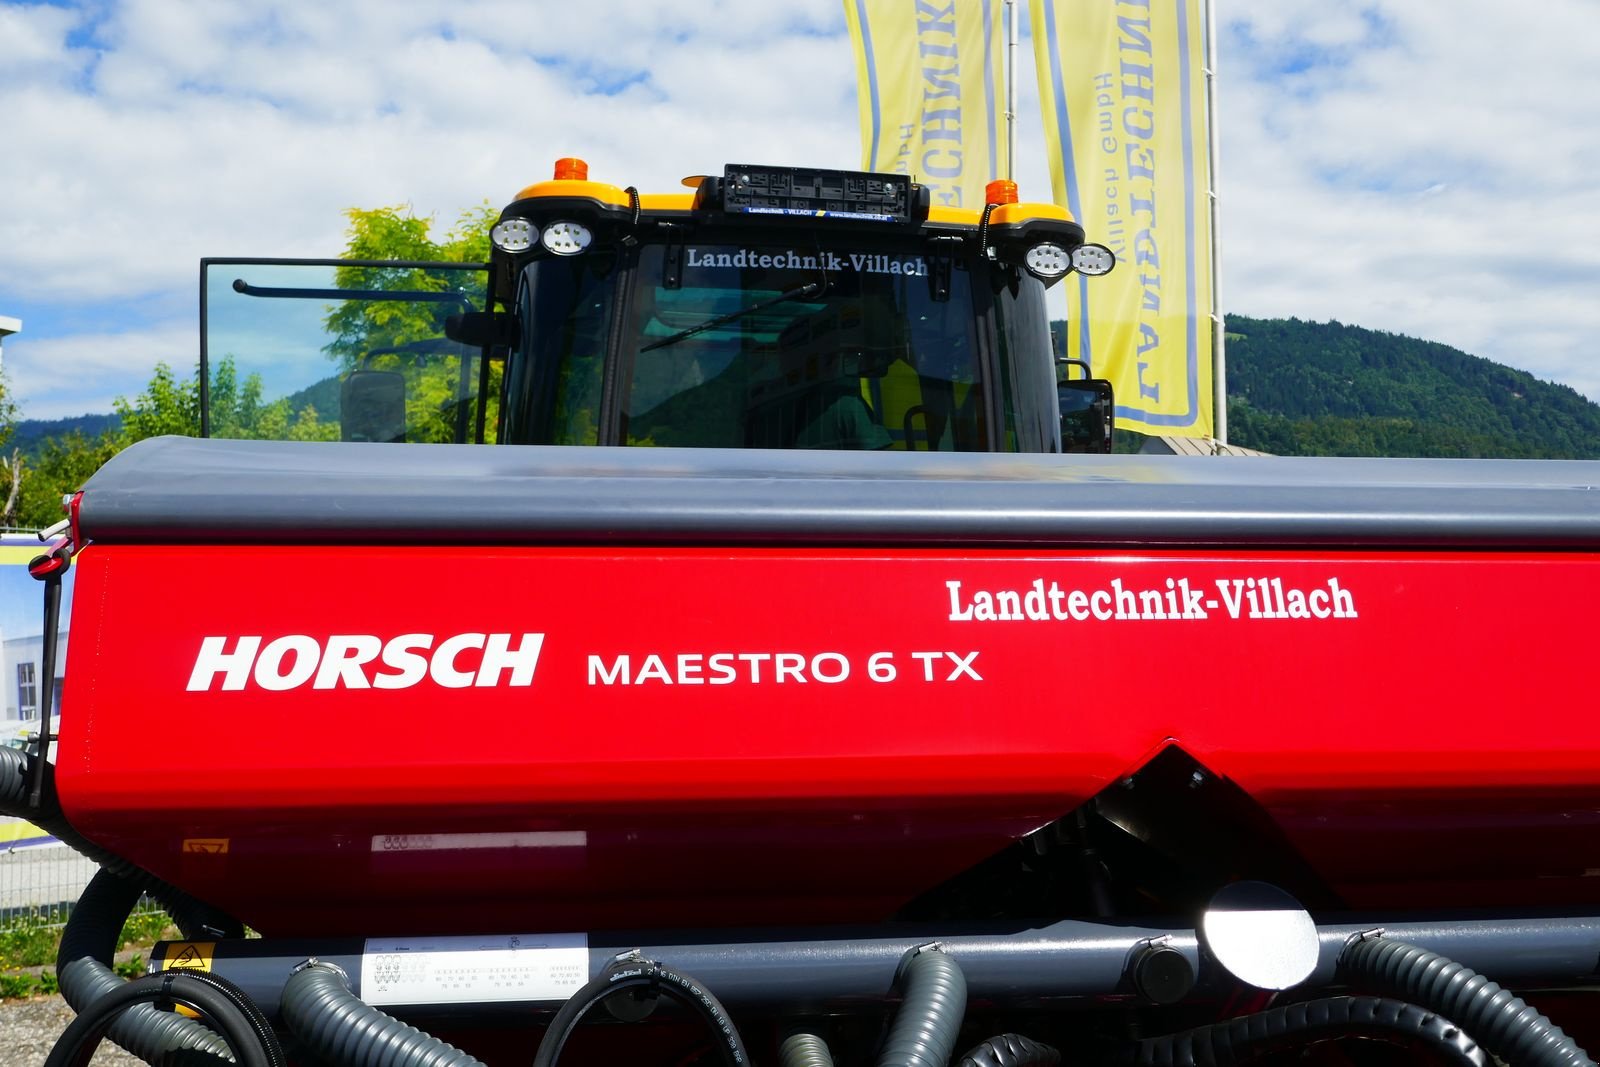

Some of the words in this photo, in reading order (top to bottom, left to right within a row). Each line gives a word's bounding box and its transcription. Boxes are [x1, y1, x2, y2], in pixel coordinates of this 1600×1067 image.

[788, 208, 812, 216] VILLACH
[687, 248, 929, 277] Landtechnik-Villach
[945, 577, 1358, 621] Landtechnik-Villach
[185, 632, 545, 691] HORSCH
[587, 652, 851, 685] MAESTRO
[867, 651, 898, 683] 6
[911, 650, 984, 682] TX
